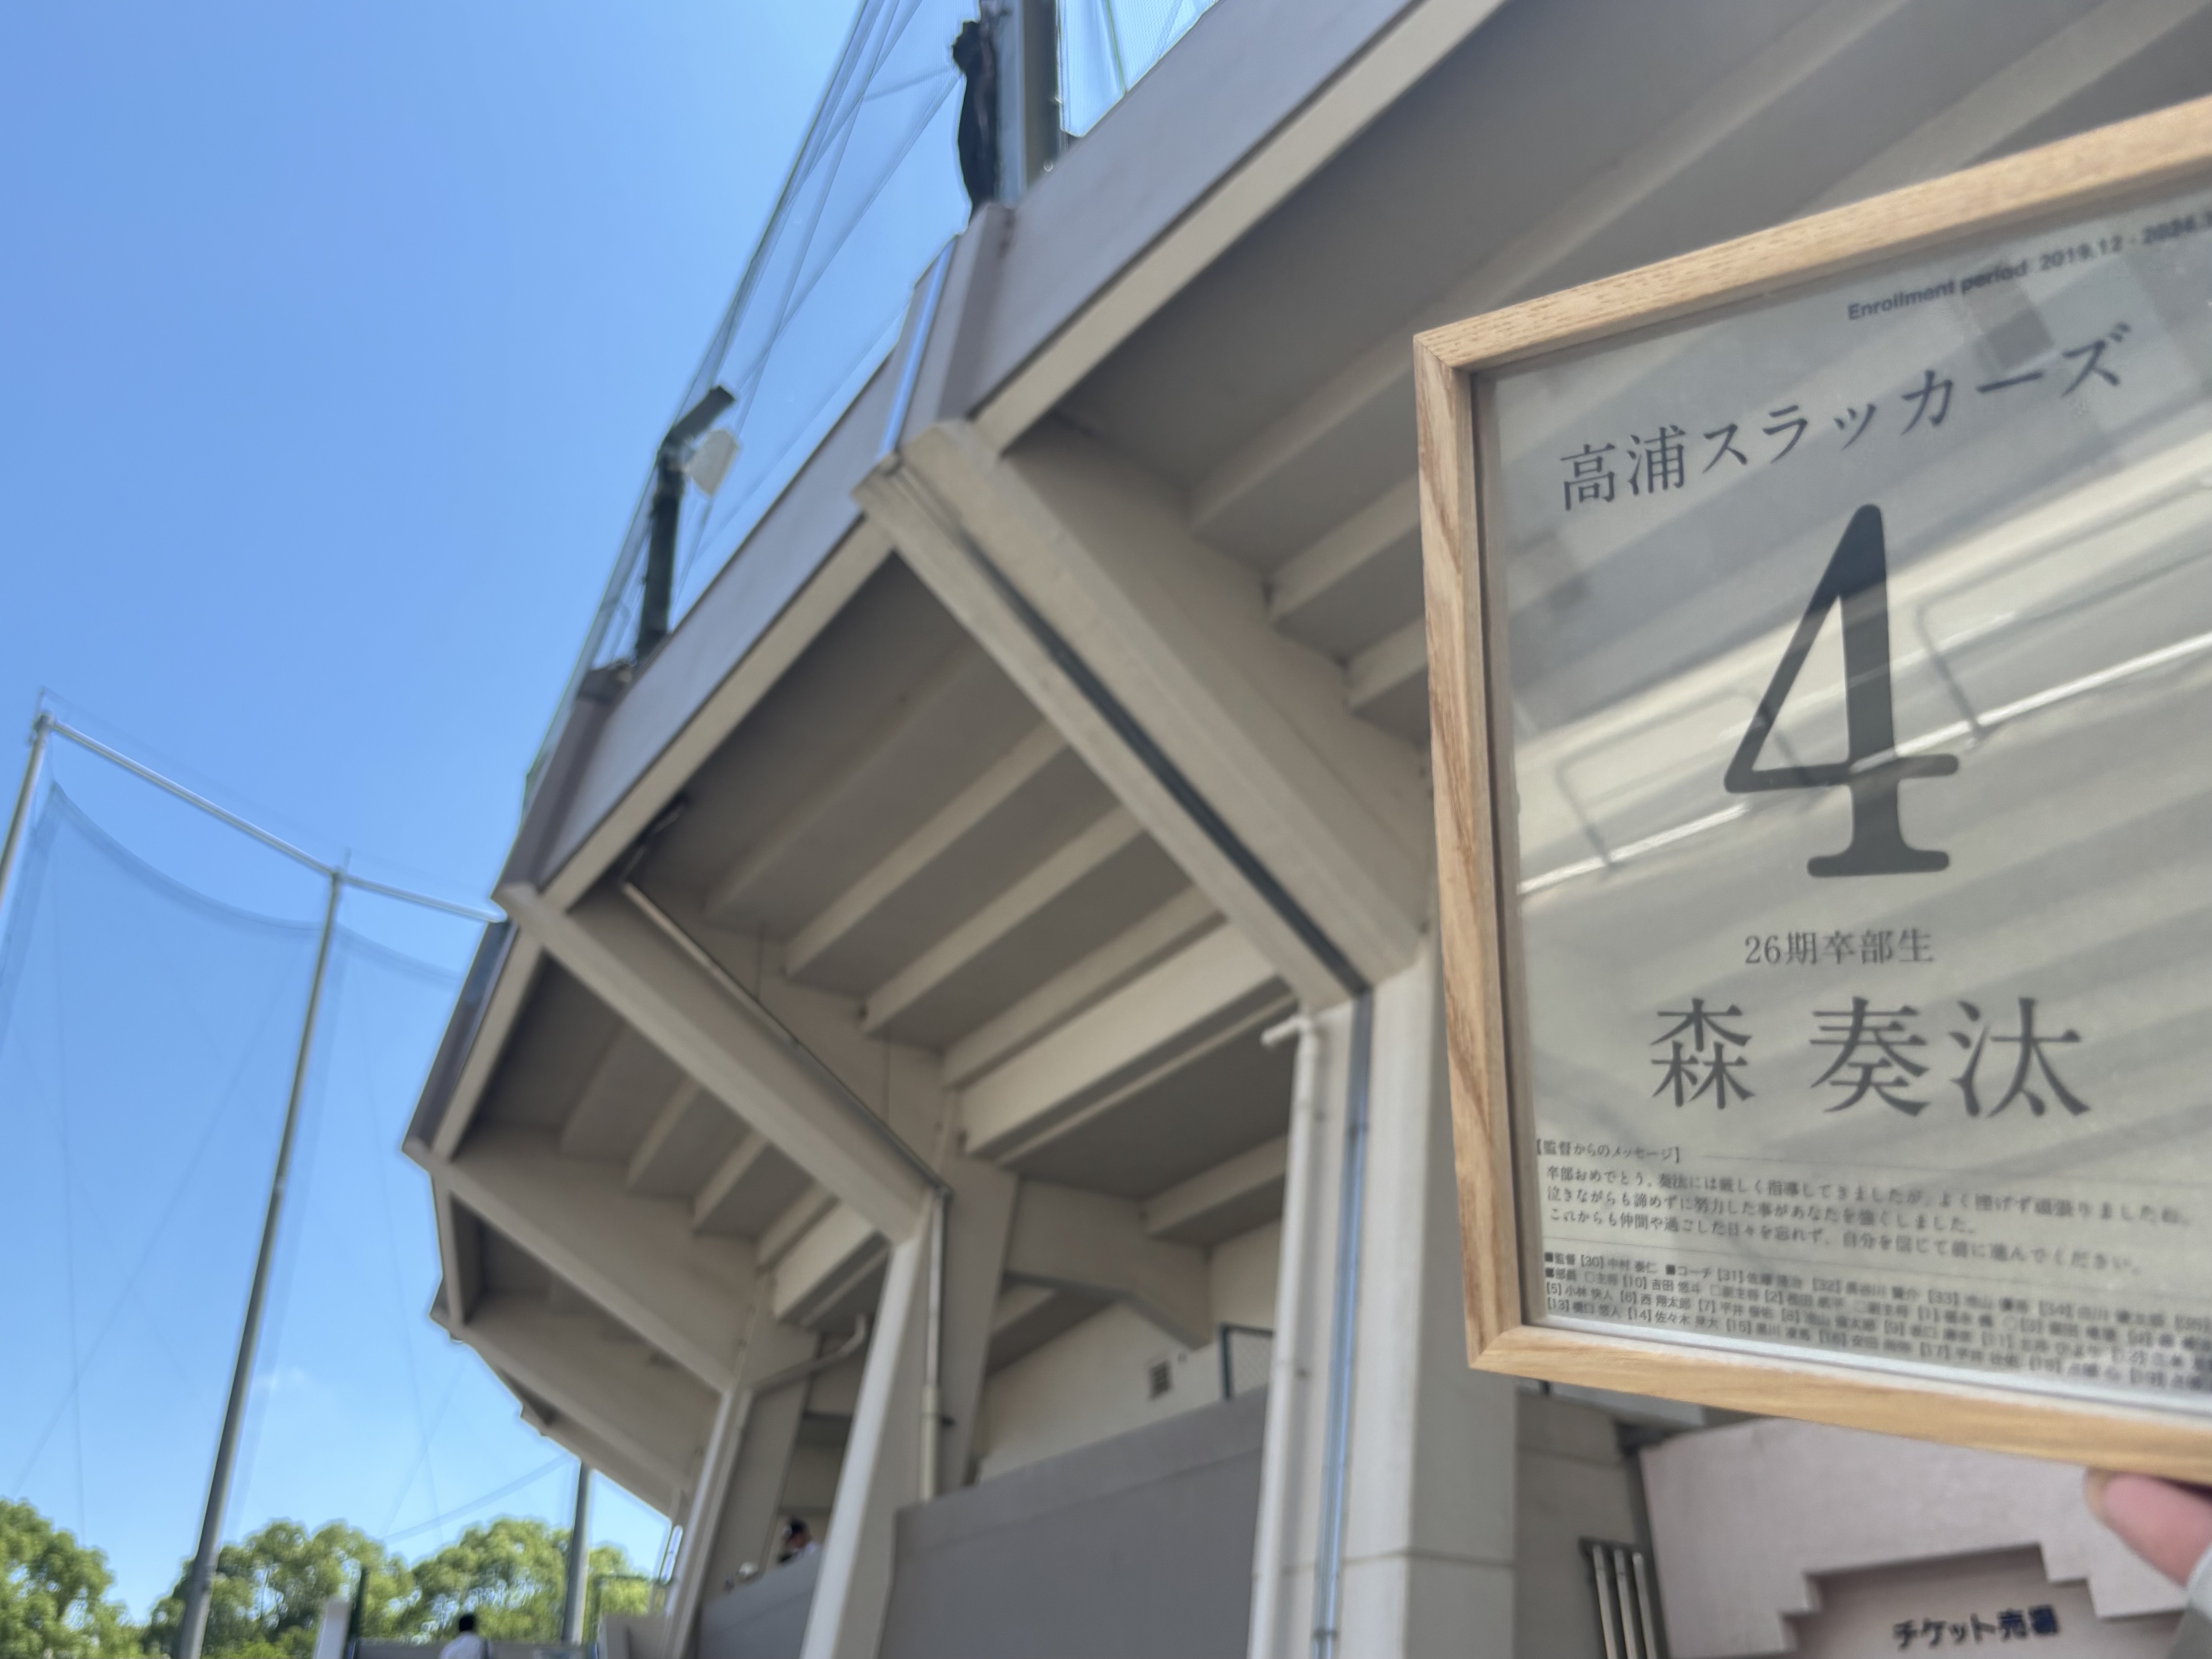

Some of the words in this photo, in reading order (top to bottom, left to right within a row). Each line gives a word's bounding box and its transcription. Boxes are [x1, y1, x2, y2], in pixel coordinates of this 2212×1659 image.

[1848, 278, 1956, 320] Enrollment
[1960, 259, 2027, 296] period
[1561, 323, 2131, 511] 高浦スラッカーズ
[1723, 504, 1959, 878] 4
[1744, 929, 1934, 965] 26期卒部生
[1650, 998, 1755, 1109] 森
[1809, 997, 2091, 1117] 奏汰
